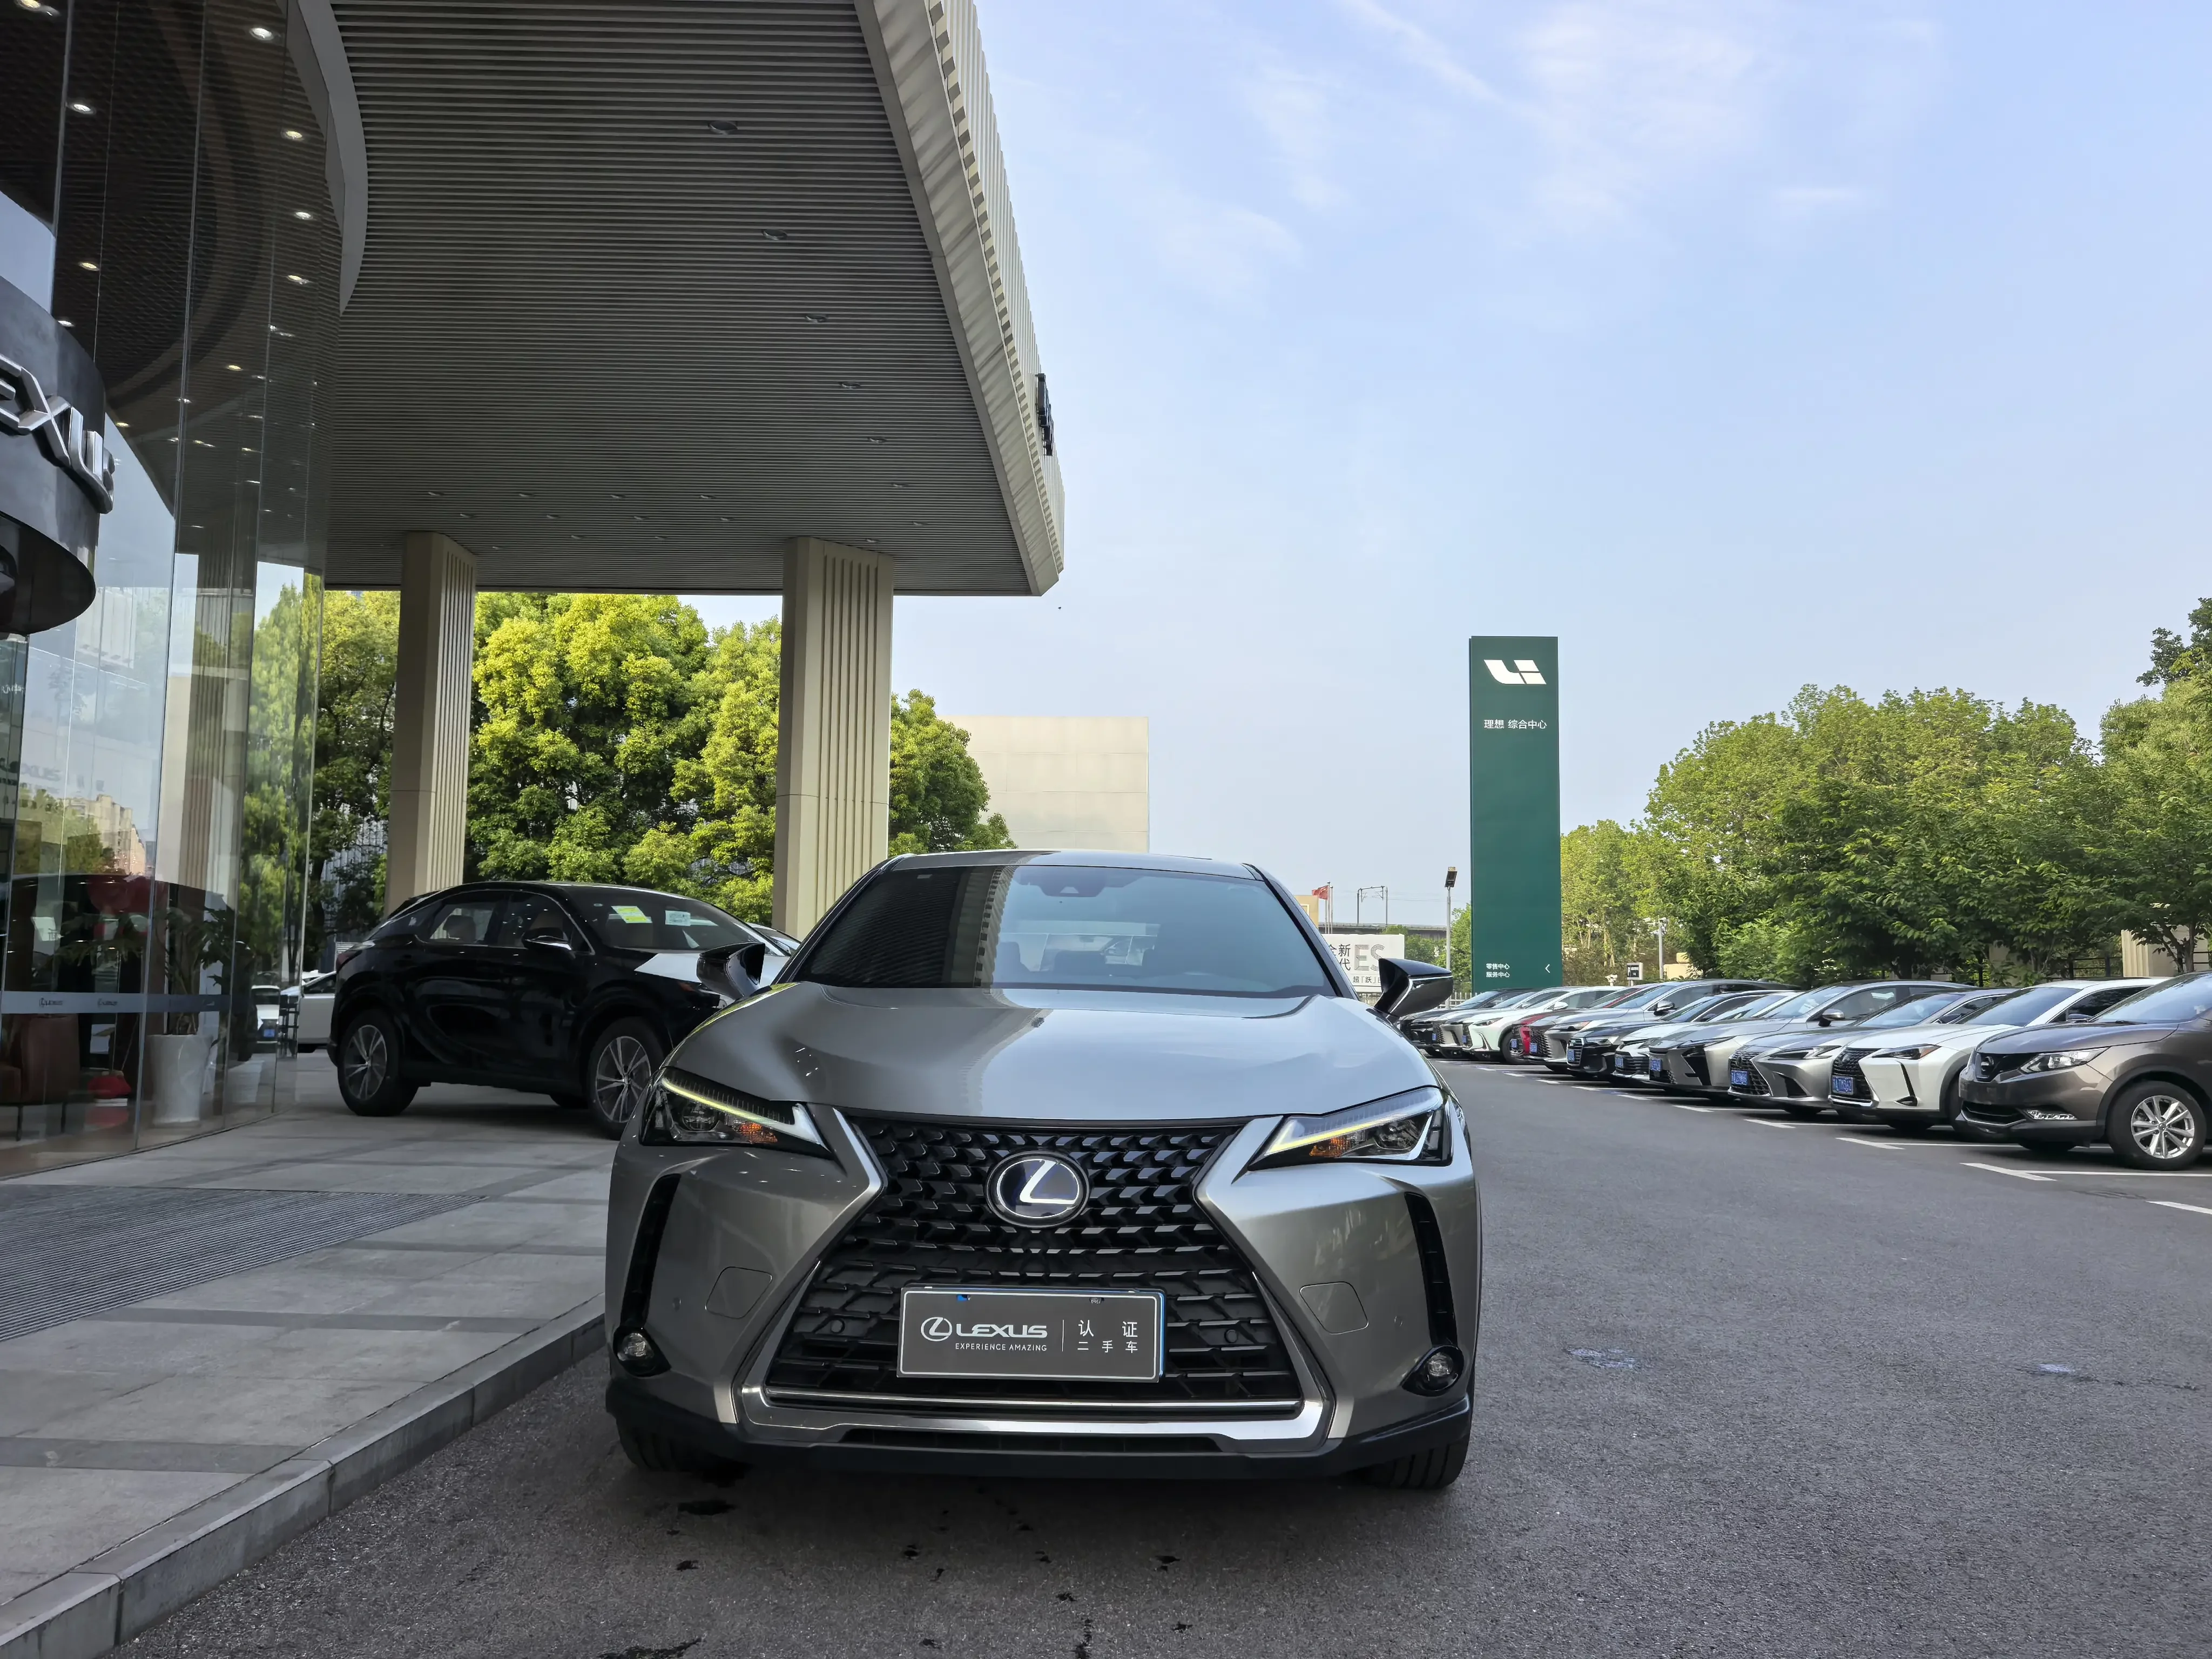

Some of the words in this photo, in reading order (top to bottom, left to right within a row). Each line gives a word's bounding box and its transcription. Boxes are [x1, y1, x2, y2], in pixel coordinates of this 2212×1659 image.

[1483, 719, 1505, 729] 理想
[1507, 719, 1547, 729] 综合中心
[1354, 944, 1385, 972] ES
[956, 1324, 1048, 1338] LEXUS
[955, 1343, 1006, 1351] EXPERIENCE
[1009, 1344, 1047, 1352] AMAZING
[1077, 1340, 1138, 1354] 二手车
